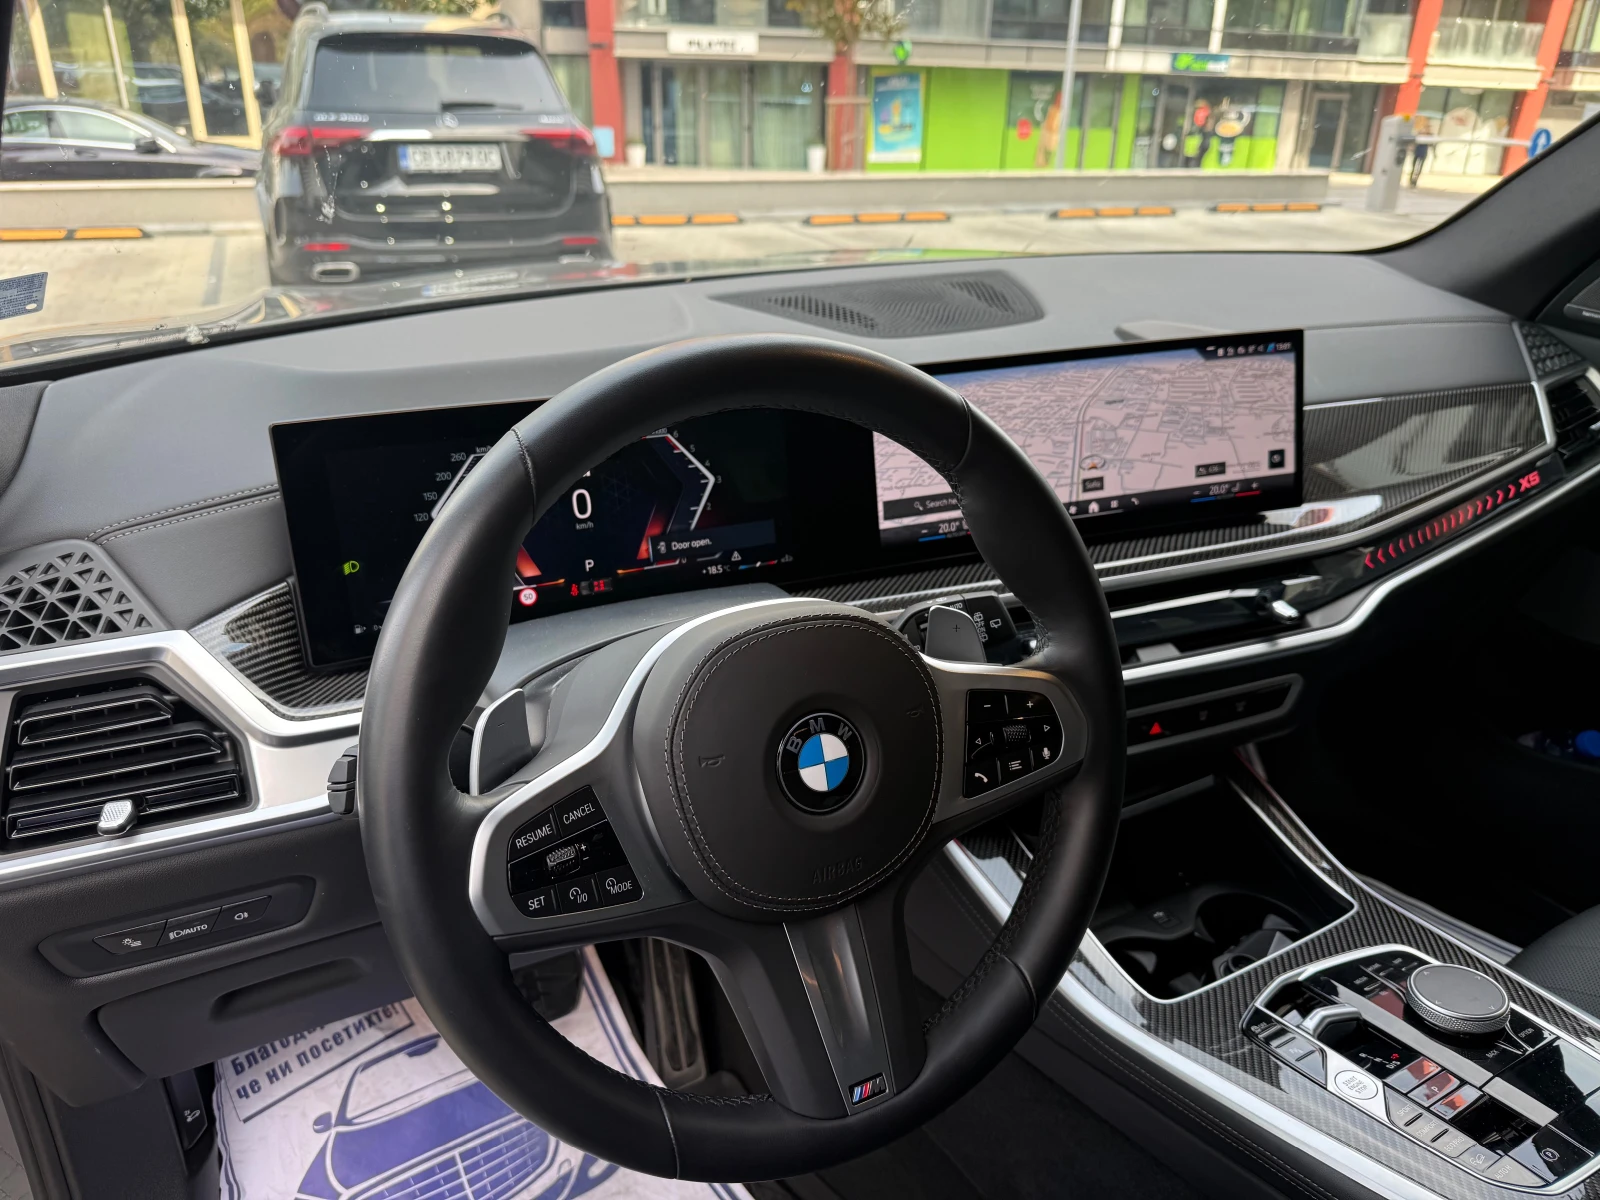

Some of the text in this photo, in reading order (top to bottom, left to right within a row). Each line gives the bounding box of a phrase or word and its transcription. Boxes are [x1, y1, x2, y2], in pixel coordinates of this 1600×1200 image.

[673, 430, 679, 438] 6
[690, 444, 696, 452] 5
[450, 452, 467, 462] 260
[435, 471, 452, 481] 200
[716, 475, 722, 484] 3
[1518, 470, 1540, 492] X5
[422, 491, 438, 501] 150
[572, 488, 592, 519] 0
[706, 502, 712, 511] 2
[925, 499, 948, 509] Search
[413, 512, 429, 522] 120
[575, 521, 594, 530] km/h
[671, 538, 712, 551] Door open.
[584, 559, 594, 572] P
[523, 592, 533, 601] 50
[786, 717, 853, 754] BMW
[563, 803, 596, 825] CANCEL
[515, 823, 553, 849] RESUME
[812, 856, 863, 885] AIRBAG
[610, 880, 633, 895] MODE
[528, 896, 546, 911] SET
[236, 1001, 401, 1100] че ни посетихте!
[1342, 1075, 1358, 1087] START
[1397, 1103, 1414, 1117] SPORT
[1416, 1120, 1439, 1138] COMFORT
